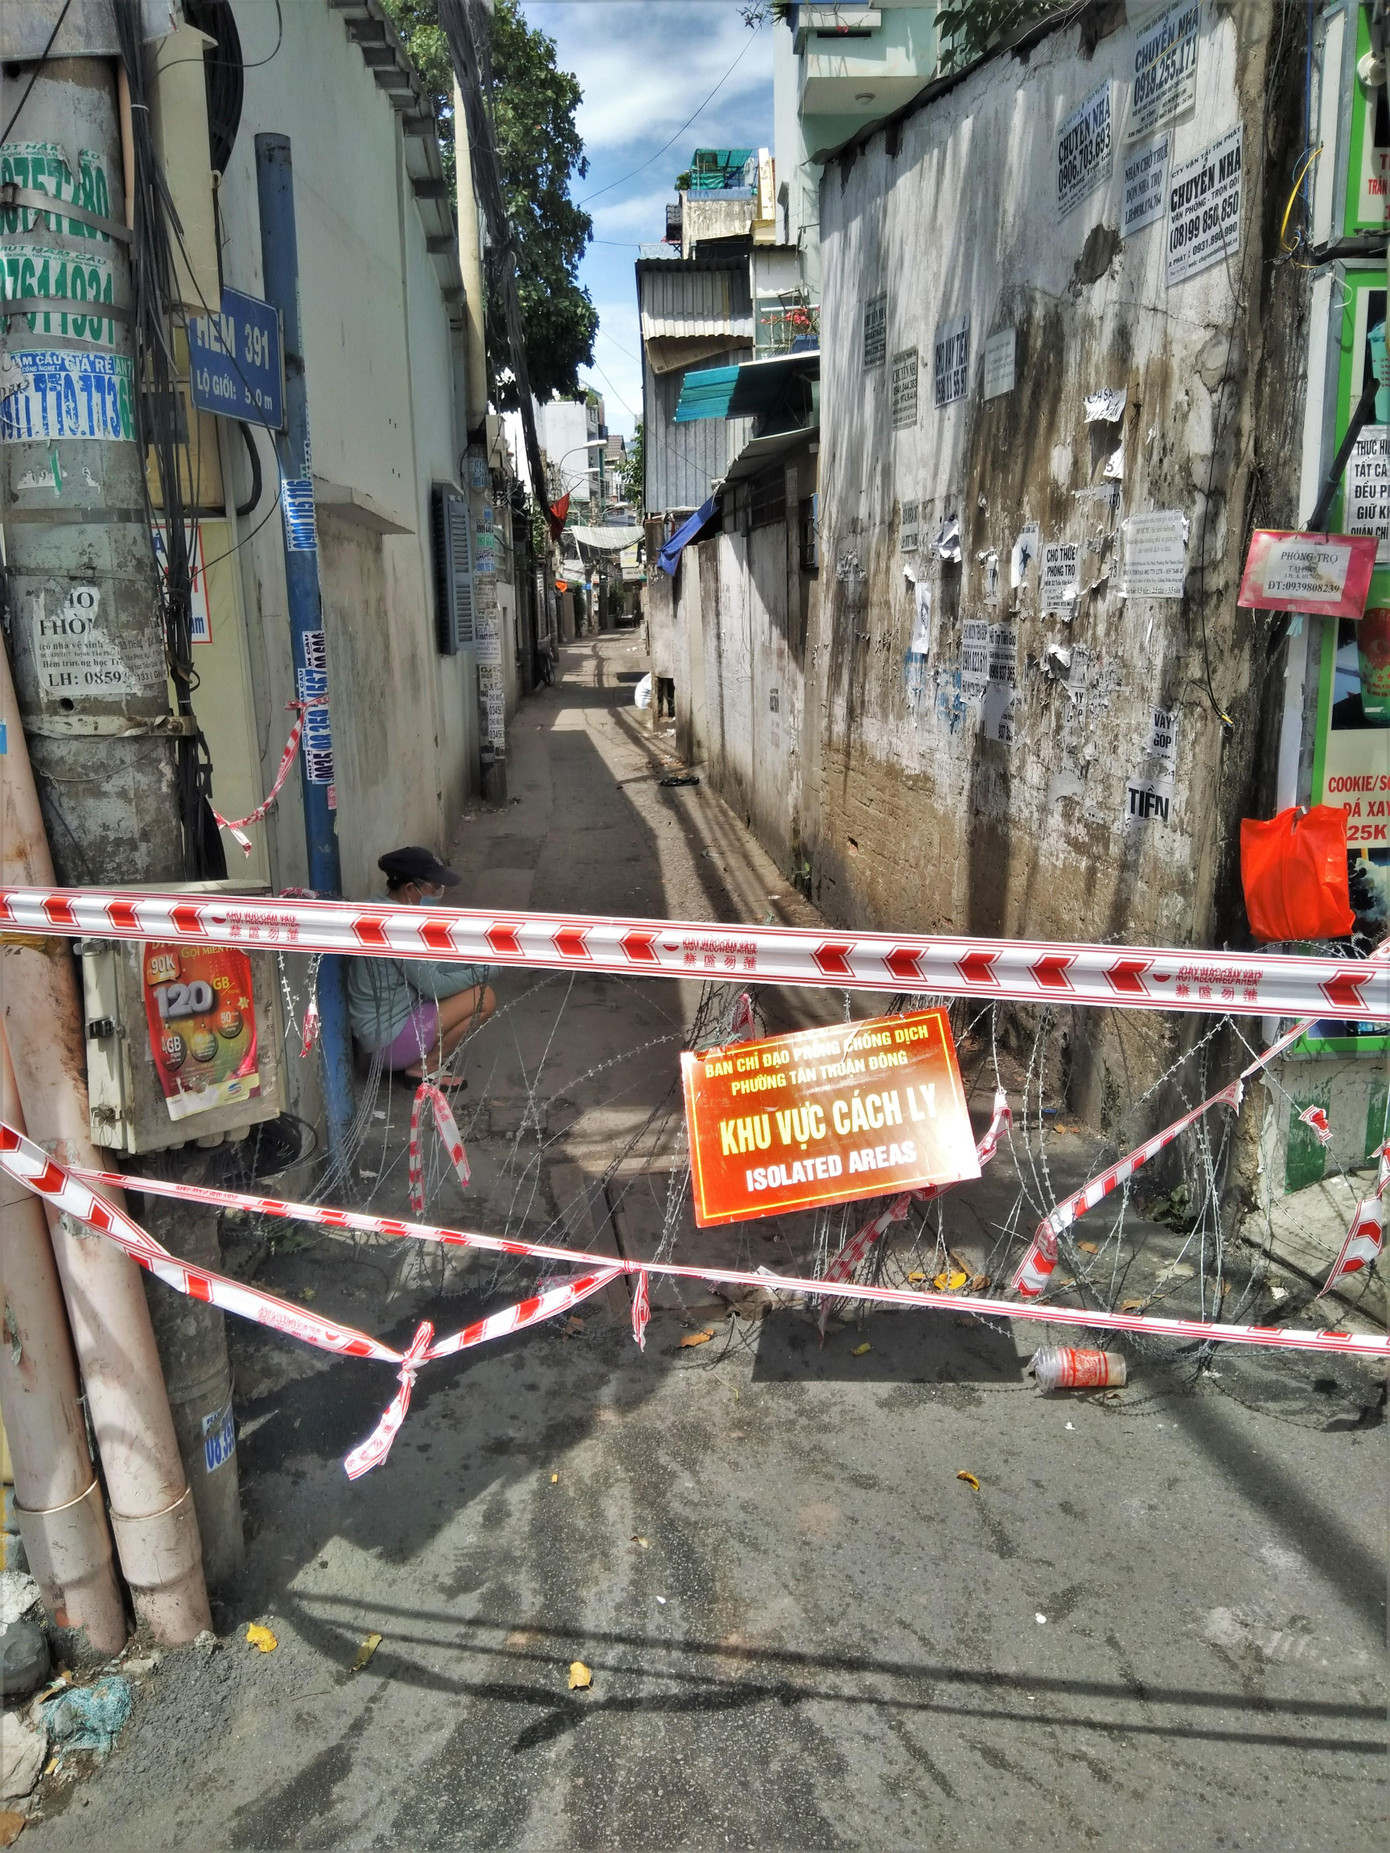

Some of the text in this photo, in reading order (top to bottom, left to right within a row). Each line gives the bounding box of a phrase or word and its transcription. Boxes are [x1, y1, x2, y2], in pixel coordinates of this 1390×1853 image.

[1059, 122, 1111, 193] 0906.703.693
[1170, 157, 1216, 213] CHUYỂN
[1218, 138, 1241, 184] NHÀ
[1172, 168, 1184, 178] CTY
[1185, 199, 1206, 218] PHÒNG
[1211, 184, 1228, 201] TRỌN
[1229, 175, 1240, 188] GÓI
[1169, 190, 1239, 254] (08)99 850 850
[244, 323, 269, 370] 391
[197, 367, 210, 398] LỘ
[212, 373, 237, 400] GIỚI:
[264, 395, 273, 411] m
[1355, 457, 1387, 477] TẤT CẢ
[286, 480, 318, 549] 0901 115 116
[1357, 504, 1376, 520] GIỮ
[1047, 549, 1058, 562] CHO
[1281, 550, 1338, 565] PHÒNG TRỌ
[1047, 562, 1076, 579] PHÒNG TRỌ
[1268, 580, 1340, 594] ĐT:0939808239
[85, 639, 104, 649] sinh
[49, 671, 79, 687] LH:
[1154, 713, 1172, 729] VAY
[1153, 732, 1172, 749] GÓP
[1347, 824, 1388, 841] 25K
[151, 954, 175, 975] 90K
[154, 976, 230, 1019] 120 GB
[221, 1011, 232, 1023] 50
[705, 1025, 929, 1078] BAN CHỈ ĐẠO PHÒNG CHỐNG DỊCH
[731, 1049, 908, 1096] PHƯỜNG TÂN THUẬN ĐÔNG
[720, 1083, 936, 1156] KHU VỰC CÁCH LY
[746, 1140, 917, 1192] ISOLATED AREAS
